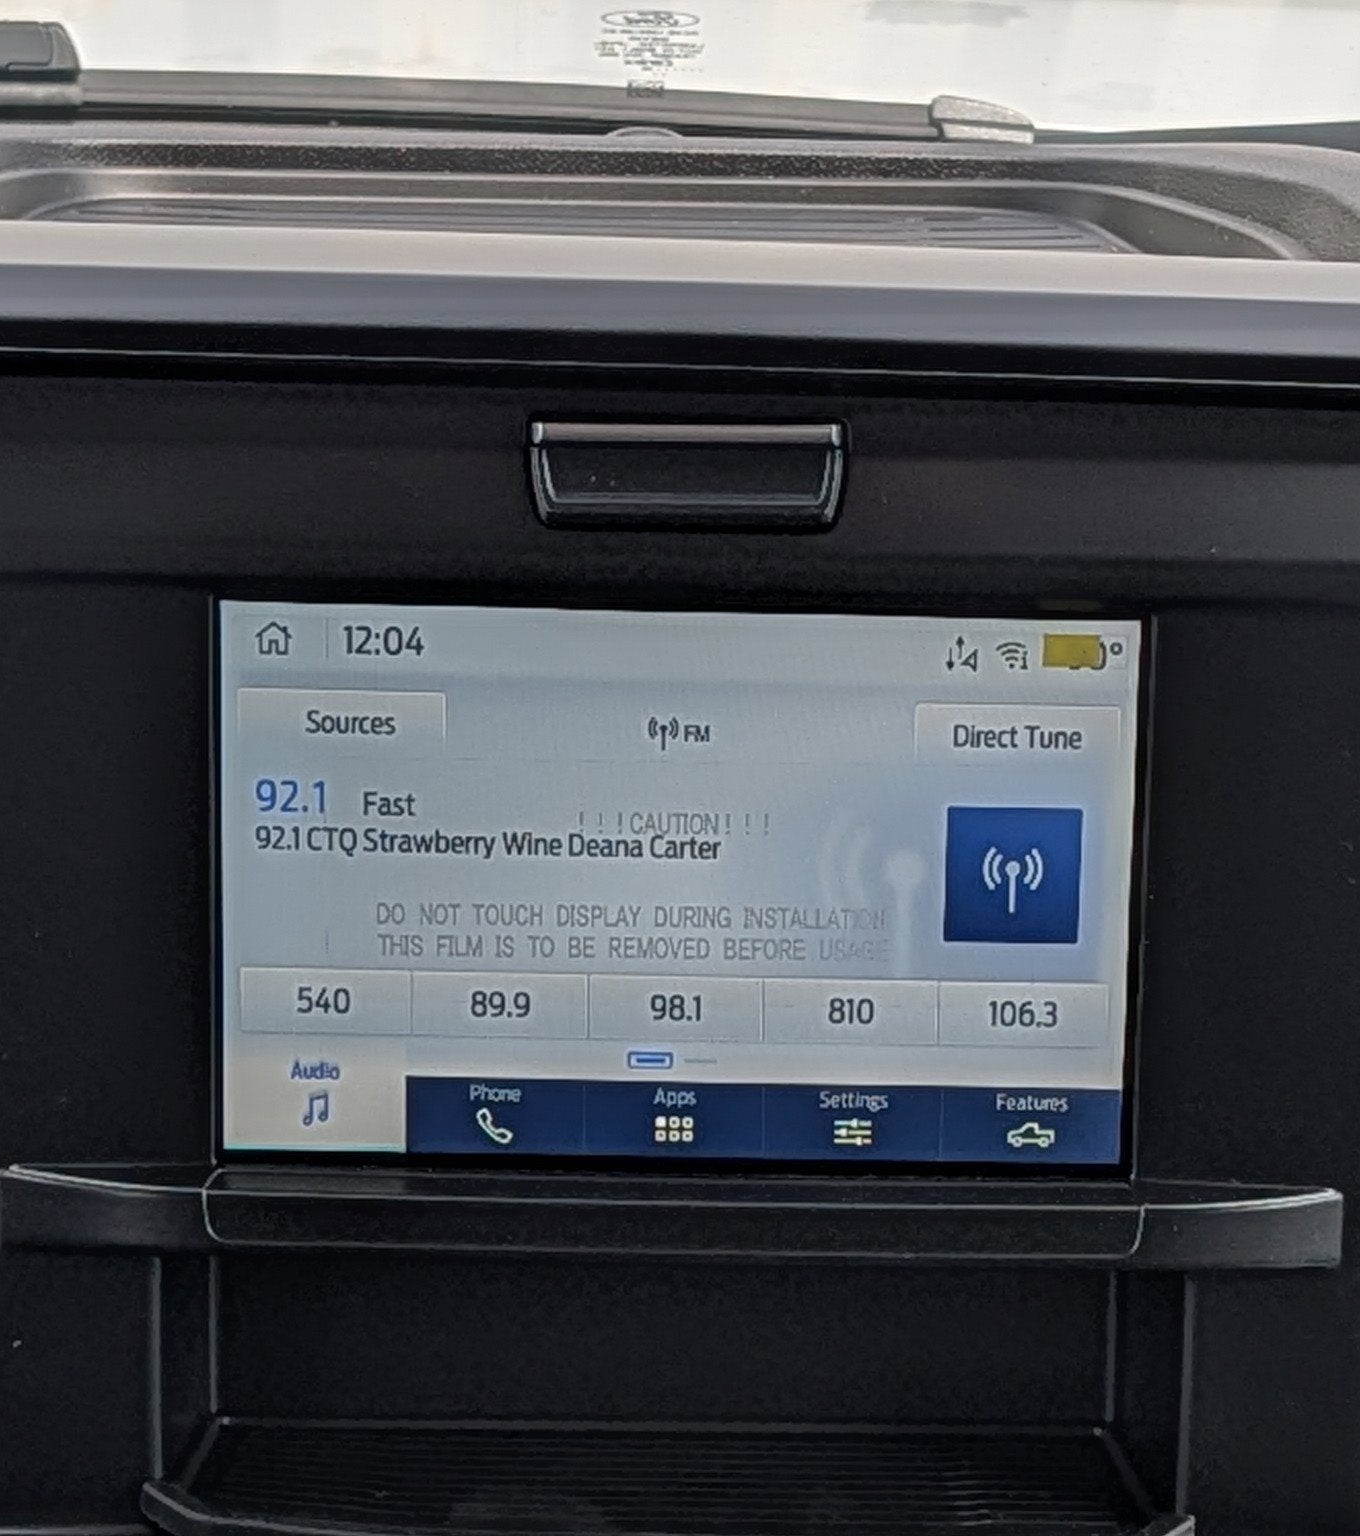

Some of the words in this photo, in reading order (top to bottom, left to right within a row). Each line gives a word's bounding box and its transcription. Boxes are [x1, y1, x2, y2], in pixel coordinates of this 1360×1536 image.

[343, 625, 425, 656] 12:04
[305, 709, 397, 736] Sources
[683, 724, 710, 743] FM
[953, 724, 1019, 749] Direct
[1024, 724, 1082, 750] Tune
[255, 778, 327, 814] 92.1
[362, 791, 416, 817] Fast
[255, 825, 300, 851] 92.1
[306, 826, 358, 857] CTQ
[362, 827, 496, 860] Strawberry
[502, 831, 563, 857] Wine
[568, 832, 643, 858] Deana
[649, 832, 722, 860] Carter
[376, 902, 406, 926] DO
[419, 902, 461, 927] NOT
[472, 903, 543, 927] TOUCH
[556, 903, 642, 928] DISPLAY
[654, 905, 732, 929] DURING
[376, 933, 424, 958] THIS
[436, 934, 483, 958] FILM
[494, 934, 515, 959] IS
[526, 934, 556, 959] TO
[568, 936, 596, 959] BE
[608, 936, 711, 960] REMOVED
[723, 937, 807, 961] BEFORE
[296, 986, 351, 1014] 540
[470, 990, 531, 1018] 89.9
[650, 994, 701, 1022] 98.1
[828, 997, 874, 1025] 810
[988, 1000, 1058, 1028] 106.3
[290, 1059, 341, 1081] Audio
[469, 1083, 522, 1103] Phone
[653, 1087, 697, 1108] Apps
[819, 1090, 889, 1113] Settings
[996, 1093, 1069, 1113] Features
